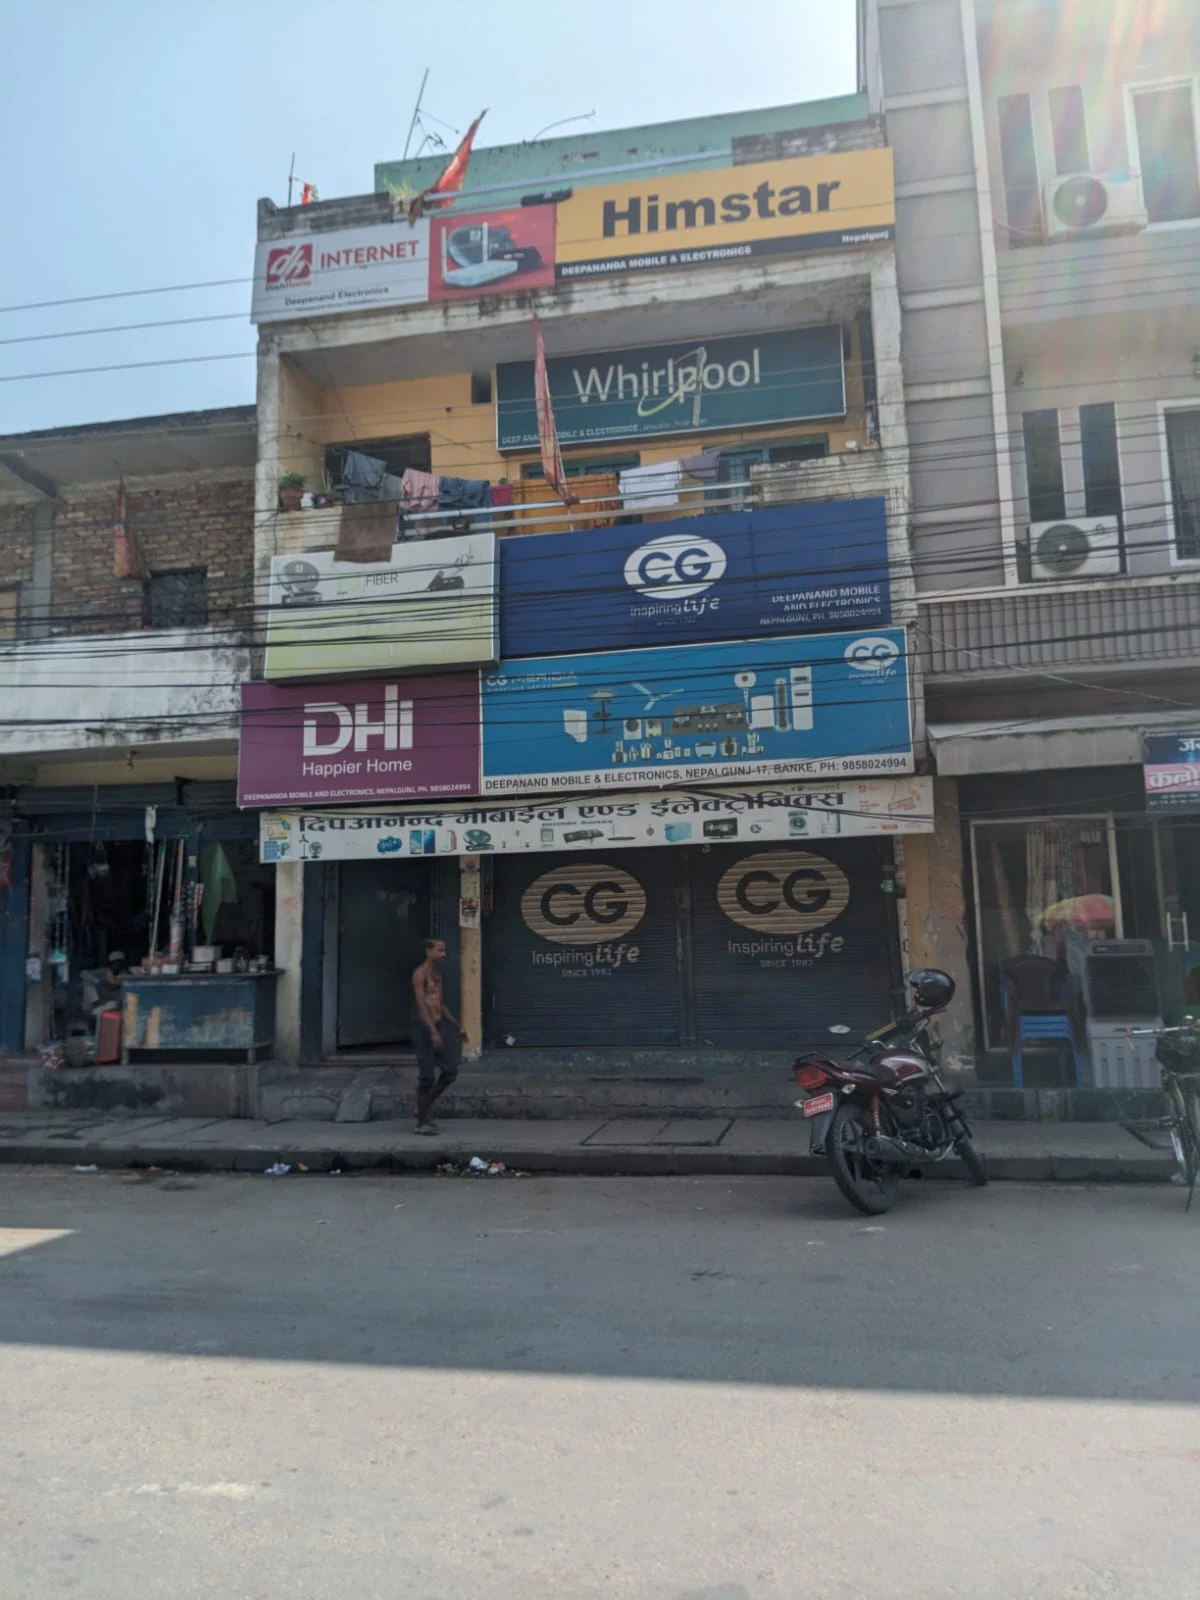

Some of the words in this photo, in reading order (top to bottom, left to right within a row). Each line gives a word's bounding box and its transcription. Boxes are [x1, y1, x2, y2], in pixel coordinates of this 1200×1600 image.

[603, 180, 841, 238] Himstar
[320, 240, 420, 269] INTERNET
[562, 261, 627, 276] DEEPANANDA
[629, 256, 667, 269] MOBILE
[670, 255, 678, 264] &
[680, 246, 752, 262] ELECTRONICS
[338, 287, 389, 300] Electronics
[573, 348, 760, 404] Whirlpool
[365, 571, 399, 587] FIBER
[638, 548, 712, 585] CG
[840, 585, 880, 597] MOBILE
[302, 760, 362, 778] Happier
[366, 759, 412, 773] Home
[485, 776, 548, 790] DEEPANAND
[551, 773, 591, 787] MOBILE
[594, 773, 601, 784] &
[603, 767, 683, 784] ELECTRONICS,
[820, 760, 838, 772] PH:
[842, 757, 907, 771] 9858024994
[289, 791, 313, 799] MOBILE
[314, 790, 329, 798] AND
[540, 880, 629, 926] CG
[735, 868, 832, 915] CG
[532, 949, 593, 968] Inspiring
[595, 943, 640, 968] life
[728, 938, 794, 957] Inspiring
[796, 931, 844, 958] life
